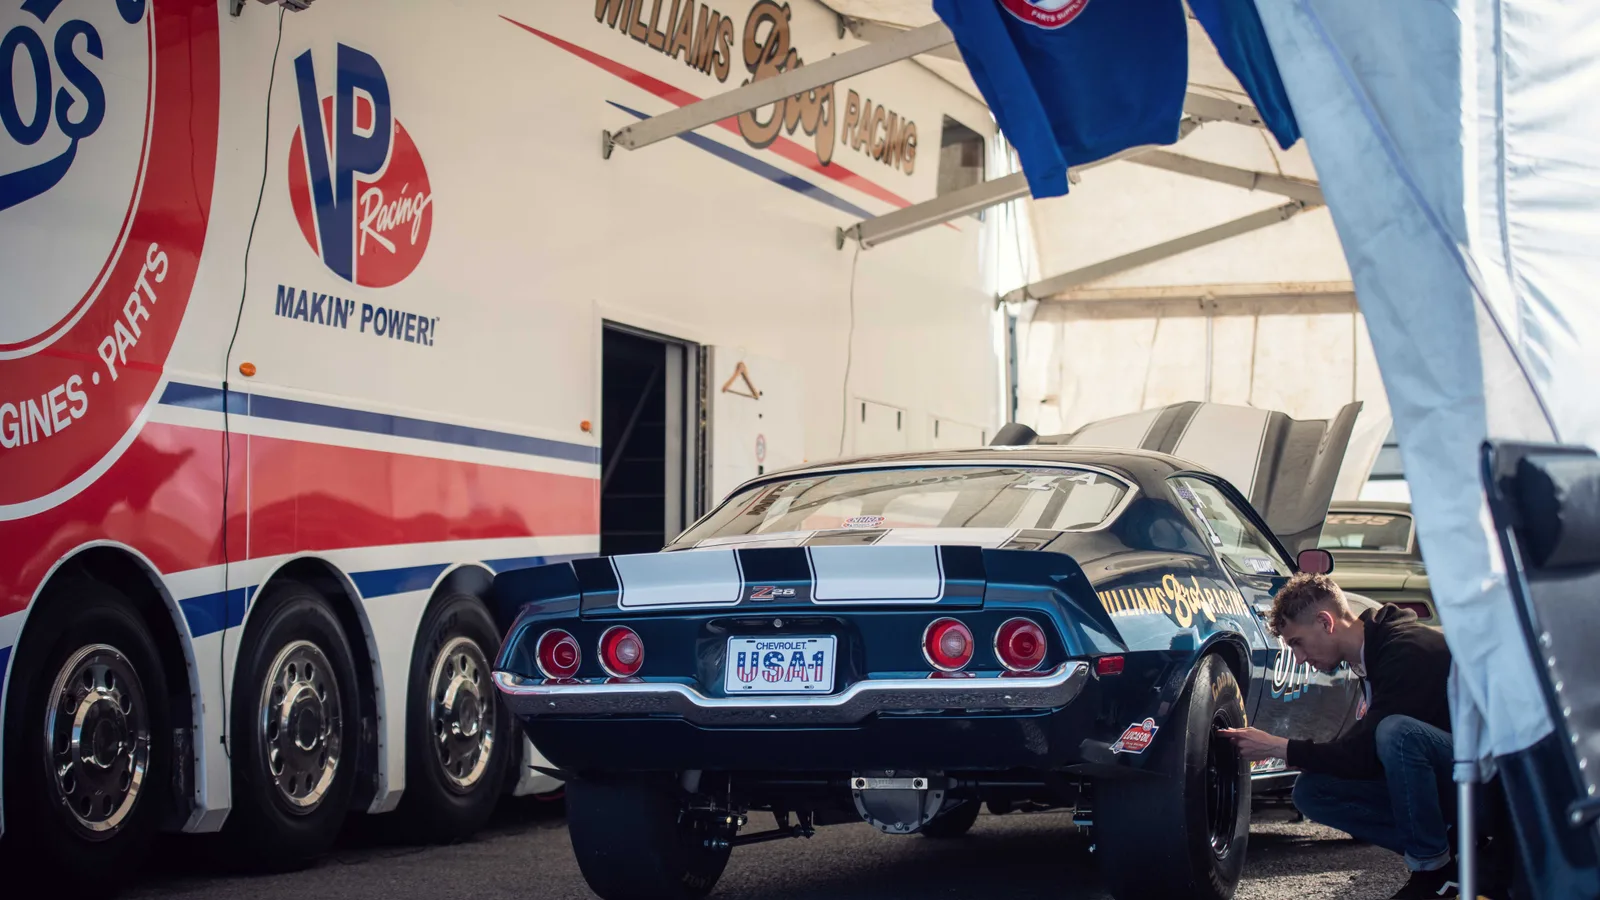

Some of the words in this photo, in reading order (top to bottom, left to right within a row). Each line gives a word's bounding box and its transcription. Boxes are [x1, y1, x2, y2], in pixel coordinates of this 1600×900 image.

[1031, 9, 1056, 22] PARTS
[841, 88, 917, 176] RACING
[294, 42, 392, 283] VP
[359, 183, 433, 255] Racing
[360, 302, 436, 347] POWER!
[0, 374, 88, 449] GINES
[98, 242, 169, 381] PARTS
[750, 585, 796, 602] Z28
[1203, 588, 1250, 618] RACING
[737, 651, 825, 683] USA-1
[1123, 731, 1142, 741] LUCAS
[1140, 733, 1151, 742] OIL
